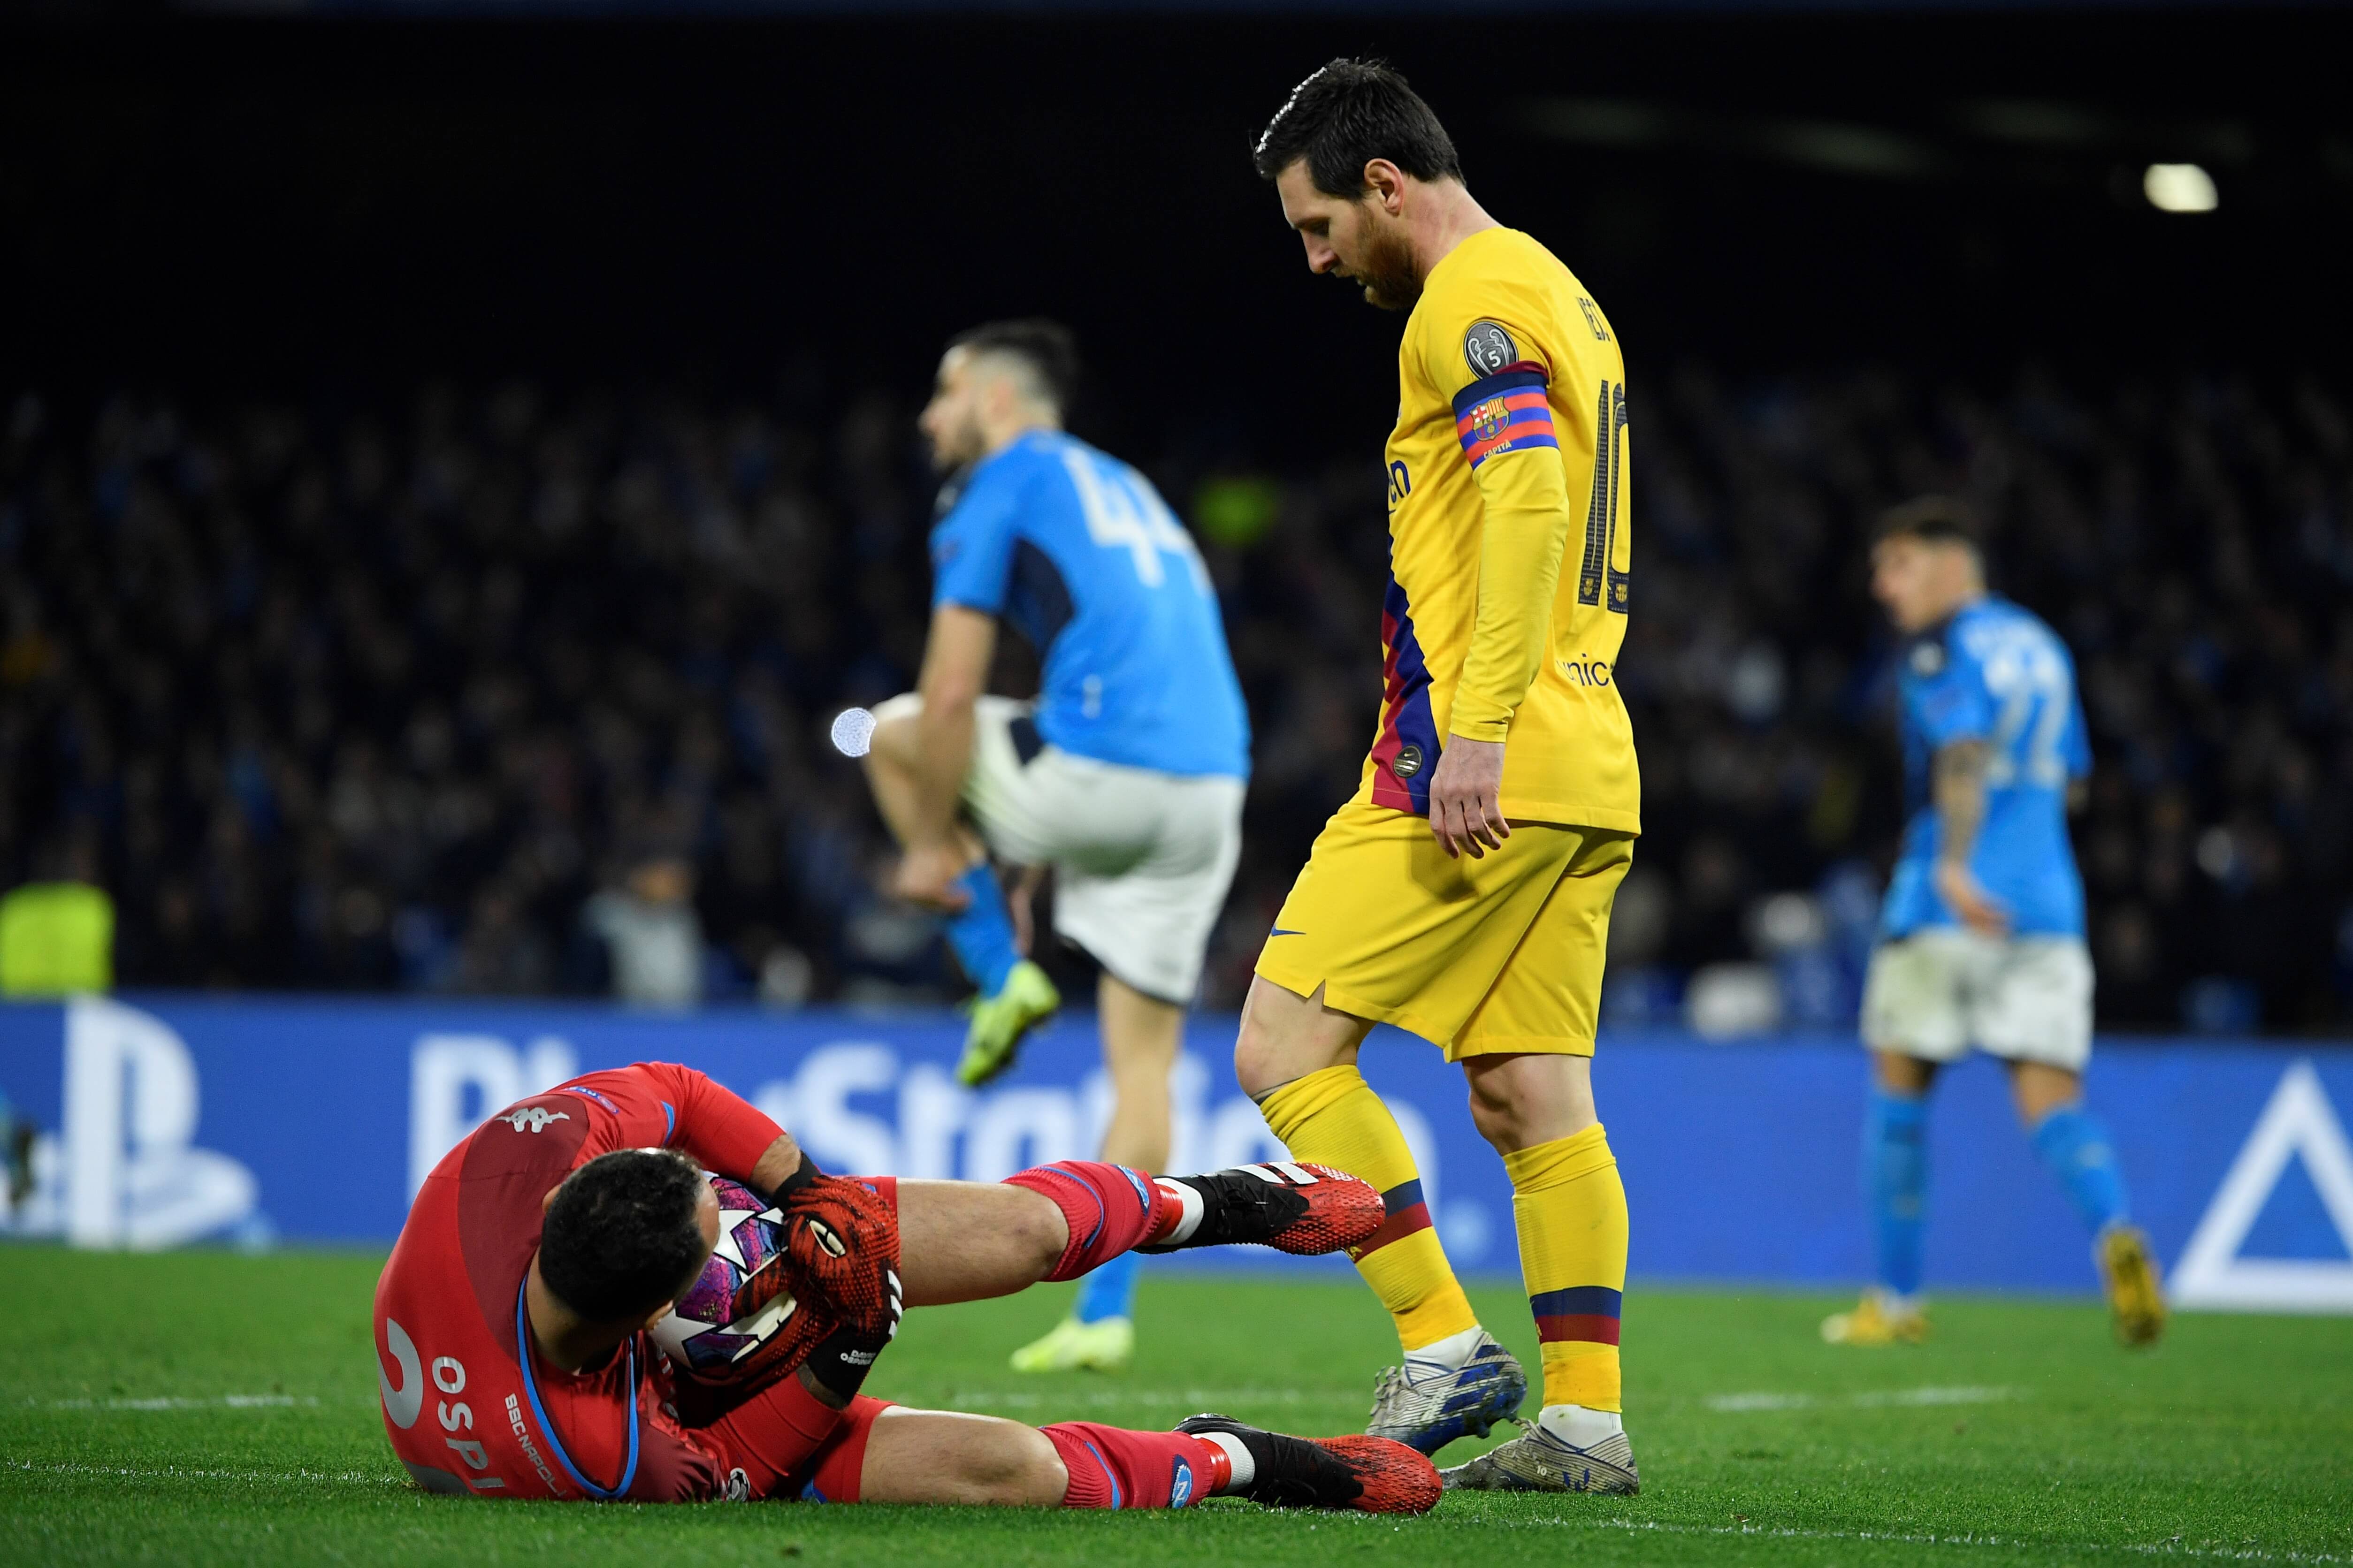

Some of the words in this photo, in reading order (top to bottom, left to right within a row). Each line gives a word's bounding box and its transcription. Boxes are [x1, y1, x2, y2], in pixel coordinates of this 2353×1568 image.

[1488, 350, 1501, 367] 5
[1062, 442, 1215, 599] 44
[504, 1393, 526, 1436] SSC
[518, 1434, 567, 1497] NAPOLI
[1536, 1465, 1547, 1477] 10
